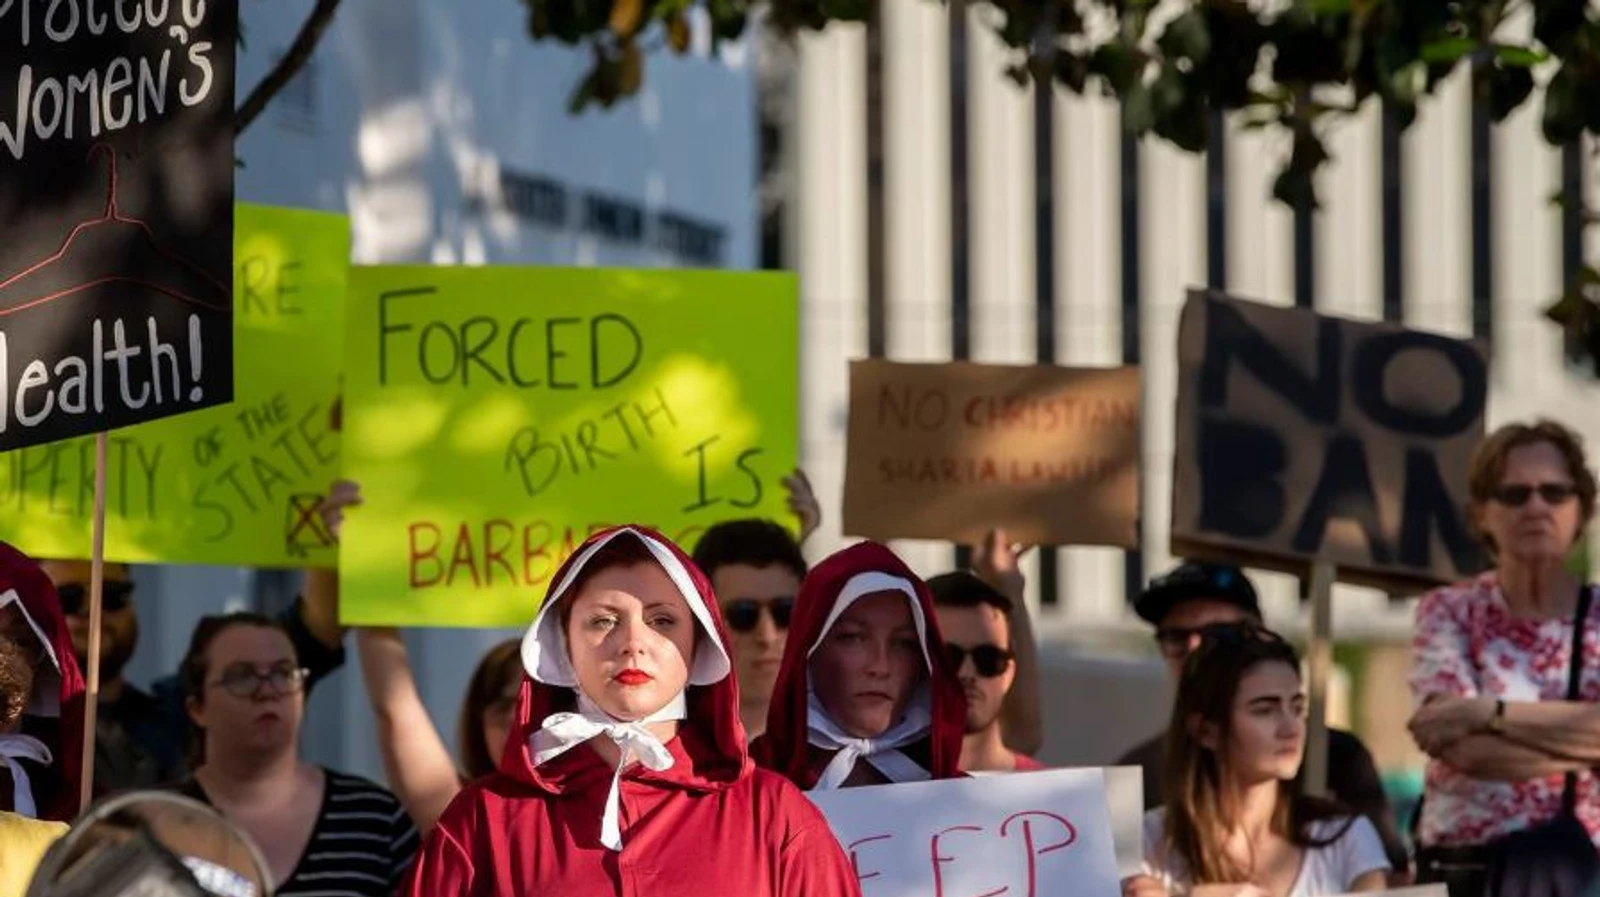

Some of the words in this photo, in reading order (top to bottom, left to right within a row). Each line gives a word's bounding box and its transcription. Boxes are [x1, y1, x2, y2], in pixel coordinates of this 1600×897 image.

[377, 285, 644, 388] FORCED
[1196, 298, 1487, 439] NO
[193, 427, 223, 468] OF
[236, 392, 290, 441] THE
[504, 386, 678, 498] BIRTH
[877, 383, 947, 432] NO
[963, 396, 1137, 430] CHRISTIAN
[190, 403, 340, 546] STATE
[681, 434, 765, 513] IS
[878, 456, 997, 484] SHARIA
[1196, 415, 1493, 574] BAN
